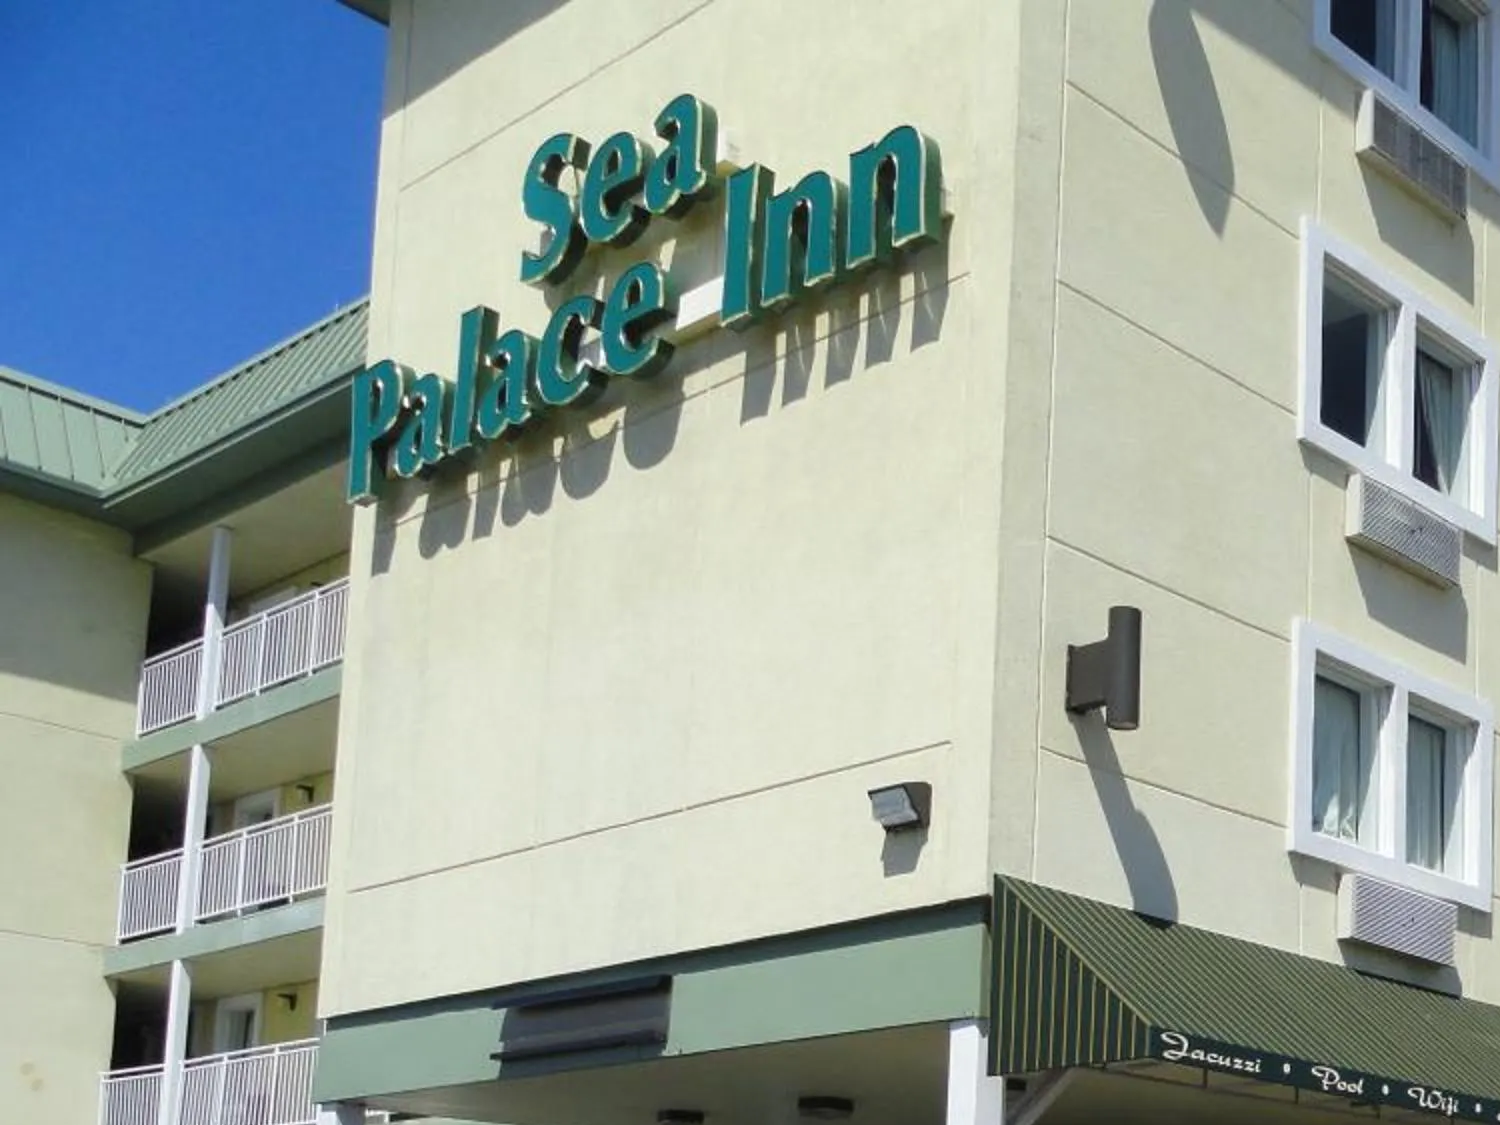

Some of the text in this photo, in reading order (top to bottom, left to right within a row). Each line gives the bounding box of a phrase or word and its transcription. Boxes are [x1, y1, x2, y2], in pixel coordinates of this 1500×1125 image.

[520, 93, 717, 286] Sea
[349, 125, 942, 506] Palace Inn
[1160, 1031, 1262, 1074] Jacuzzi
[1311, 1065, 1365, 1095] Pool
